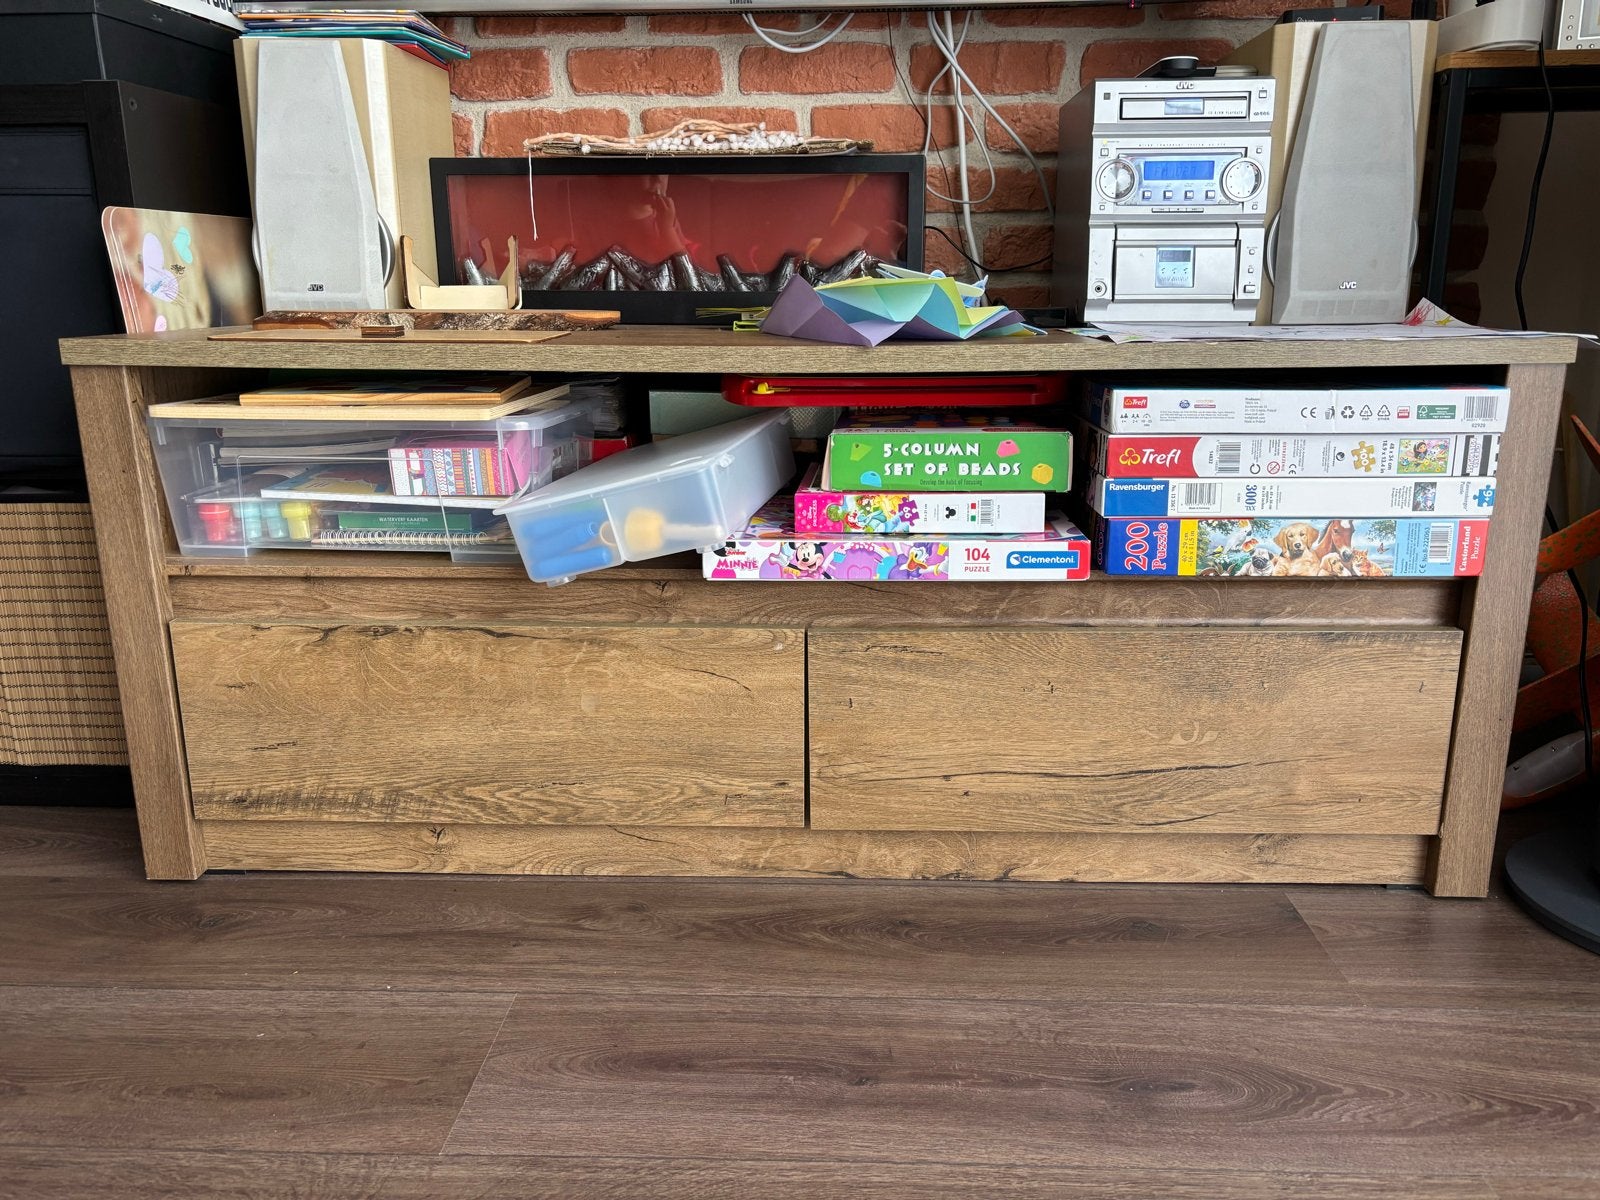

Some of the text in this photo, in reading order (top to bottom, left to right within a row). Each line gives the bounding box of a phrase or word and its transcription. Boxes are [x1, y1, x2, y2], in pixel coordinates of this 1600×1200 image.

[1176, 81, 1195, 90] JVC
[308, 283, 324, 291] JVC
[1339, 281, 1357, 289] JVC
[1132, 399, 1147, 407] Trefl
[883, 443, 980, 457] 5-COLUMN
[1142, 448, 1181, 468] Trefl
[1360, 449, 1369, 465] 100
[883, 463, 1022, 476] SET OF BEADS
[1109, 483, 1165, 492] Ravensburger
[1245, 484, 1257, 506] 300
[902, 506, 913, 519] 99
[1124, 522, 1150, 571] 200
[1151, 522, 1169, 570] Puzzle
[1459, 525, 1472, 572] Castorland
[1470, 536, 1481, 559] Puzzle
[964, 548, 990, 561] 104
[1022, 555, 1074, 564] Clementoni
[716, 558, 758, 570] MINNIE
